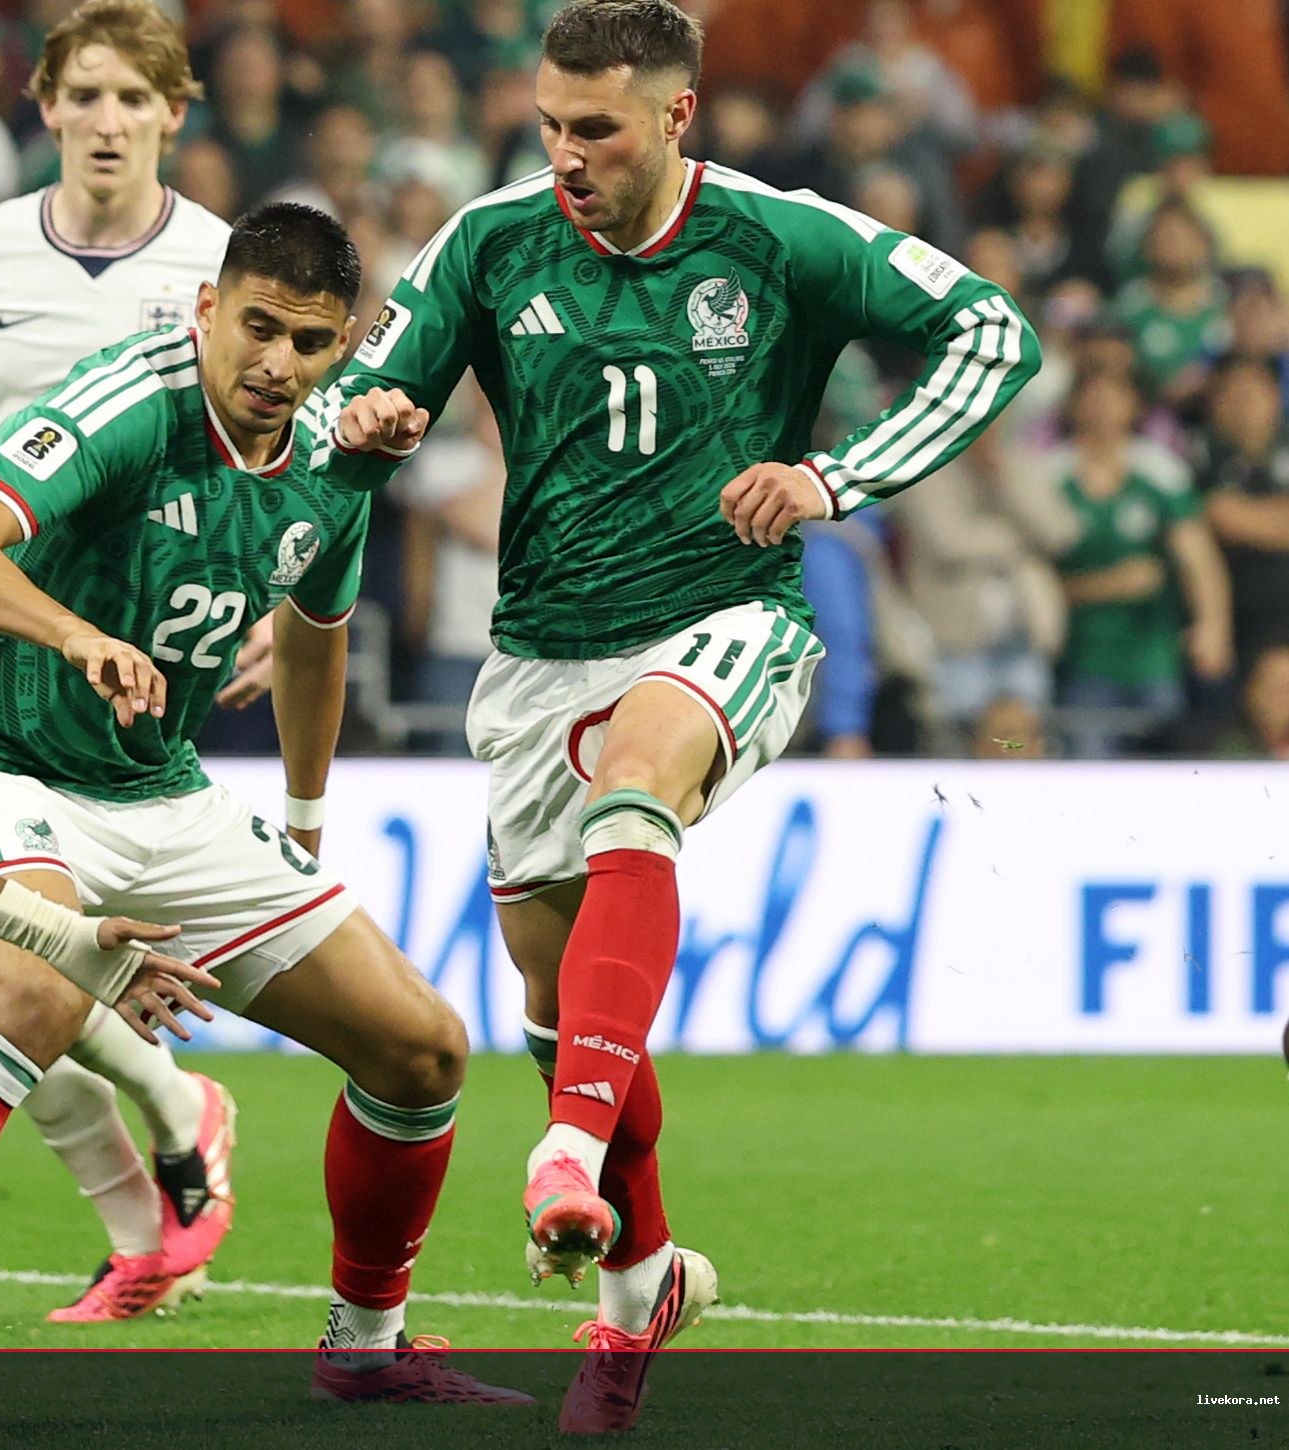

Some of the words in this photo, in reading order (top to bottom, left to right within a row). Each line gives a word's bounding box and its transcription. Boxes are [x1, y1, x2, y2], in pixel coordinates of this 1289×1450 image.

[694, 333, 747, 349] MÉXICO
[602, 364, 658, 455] 11
[152, 583, 247, 669] 22
[678, 632, 748, 681] 11
[382, 797, 944, 1051] Wrld
